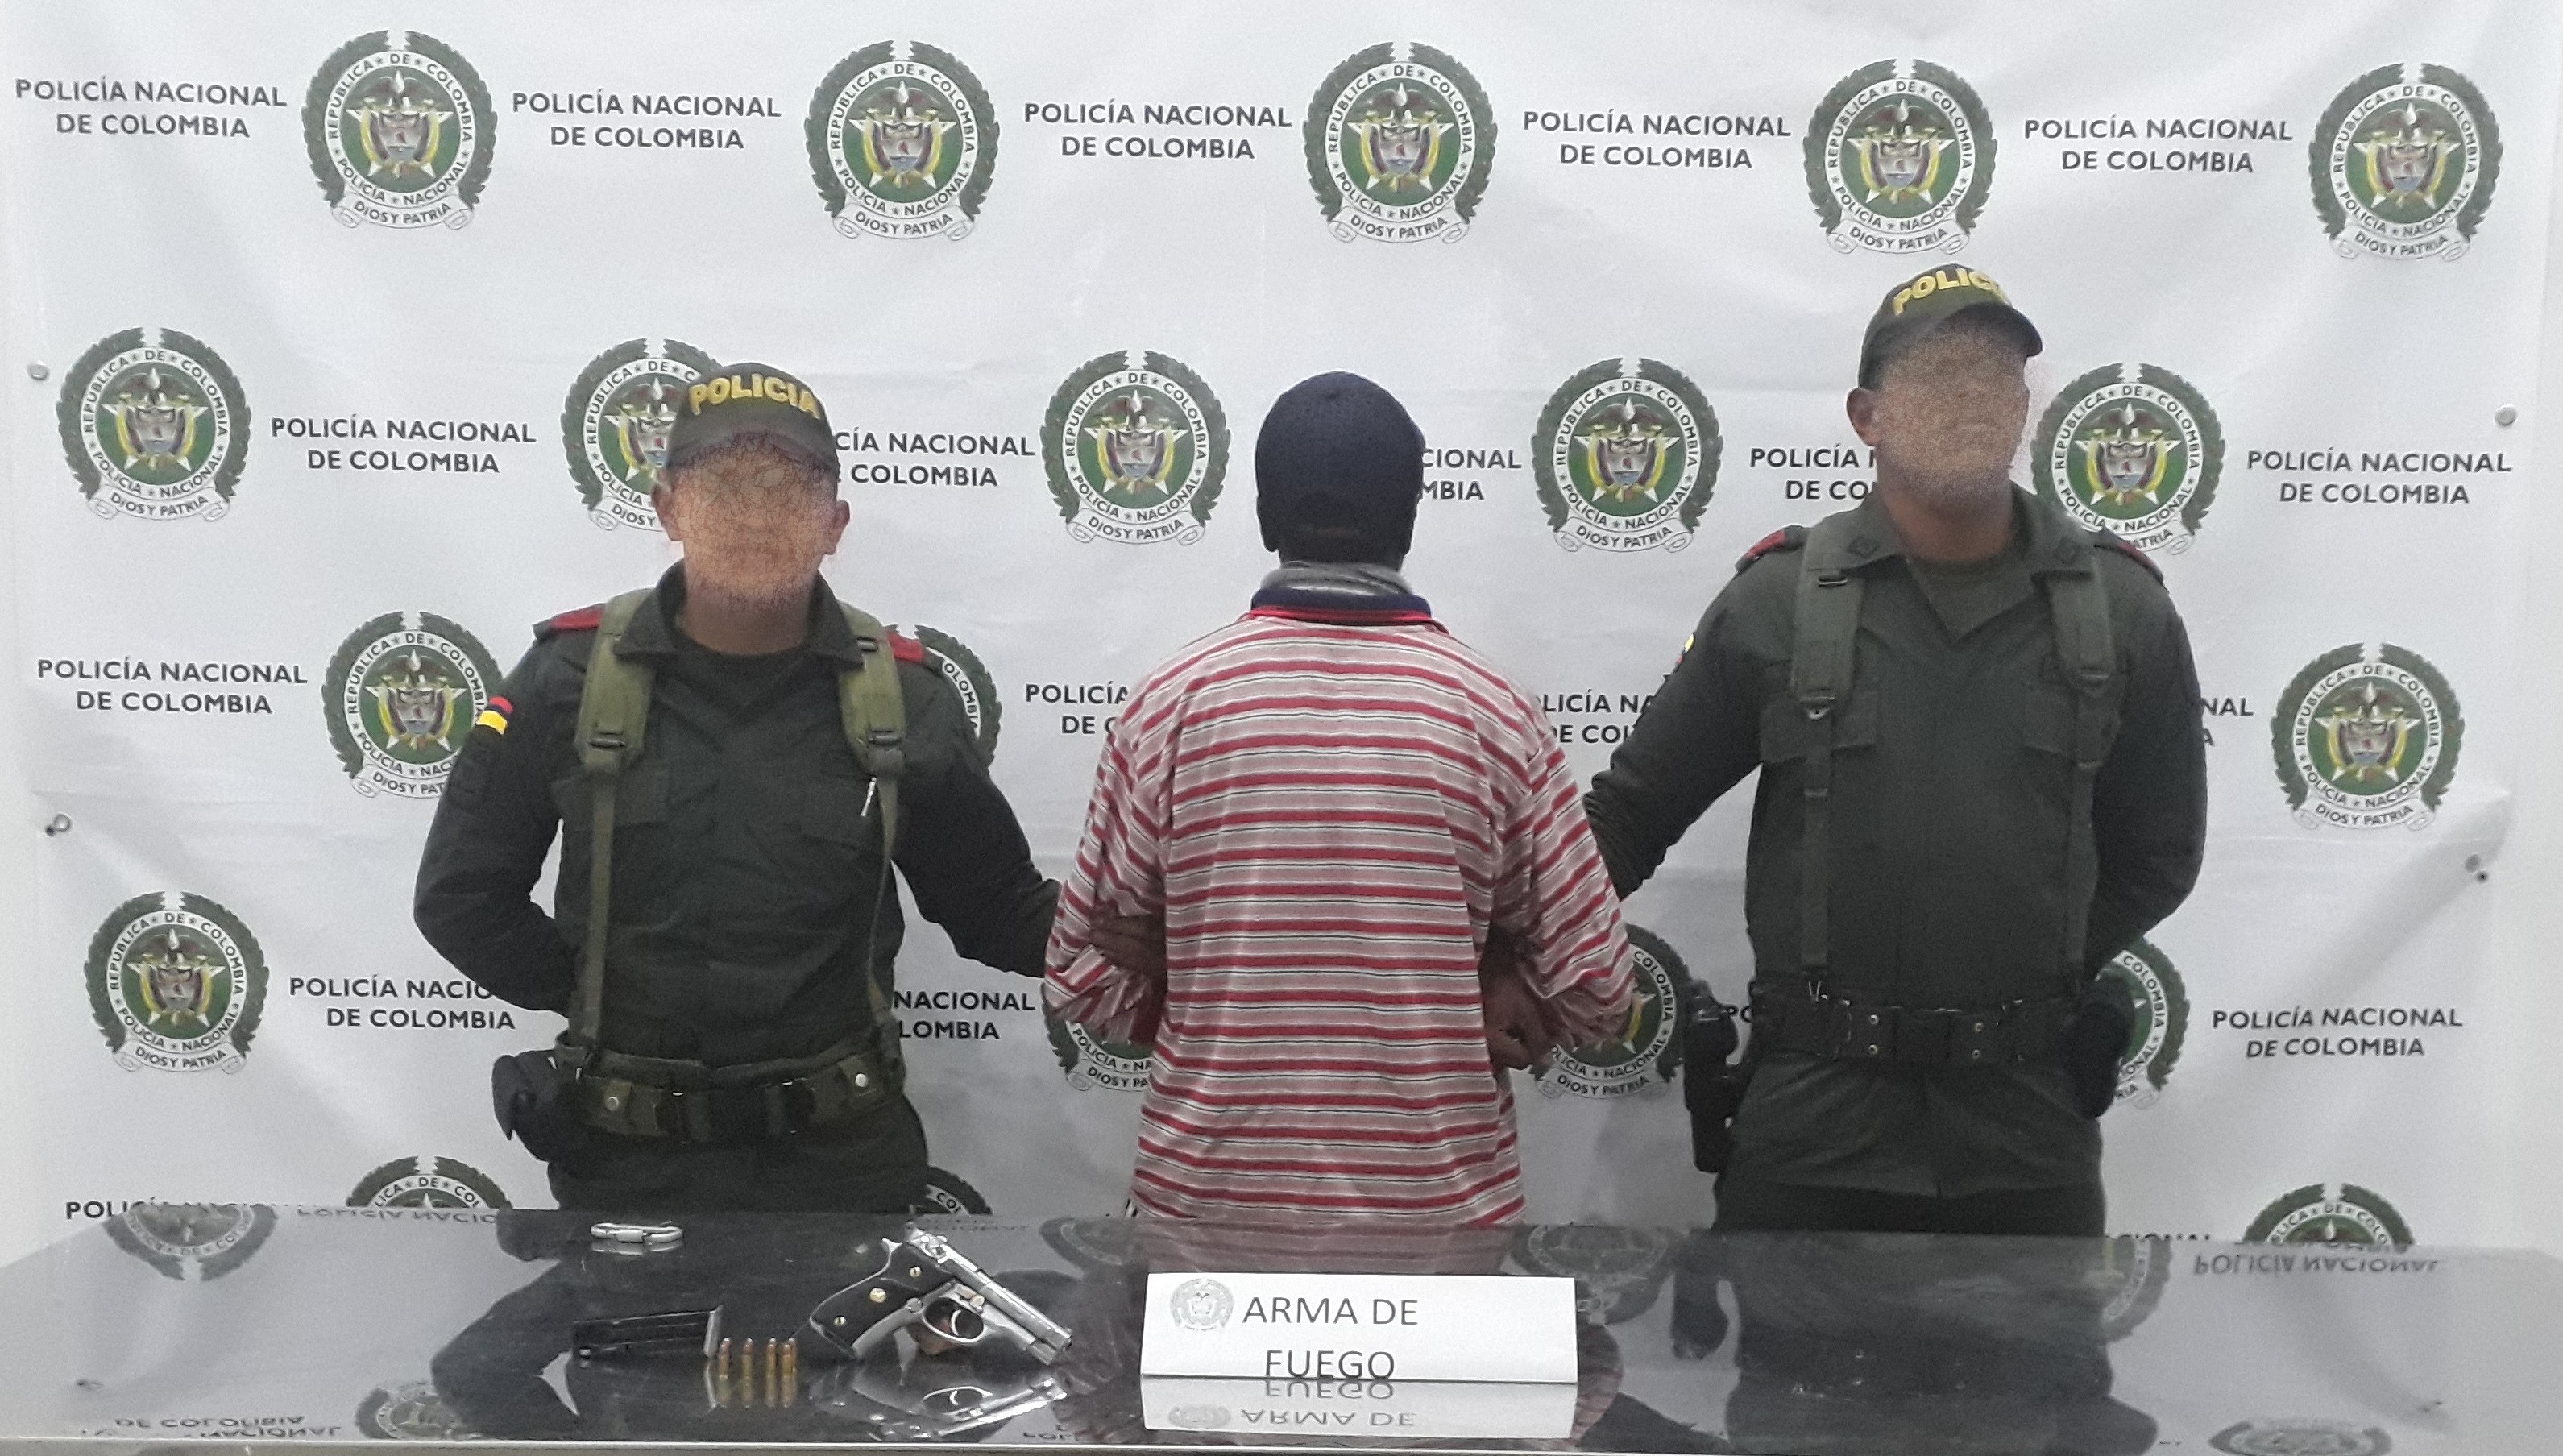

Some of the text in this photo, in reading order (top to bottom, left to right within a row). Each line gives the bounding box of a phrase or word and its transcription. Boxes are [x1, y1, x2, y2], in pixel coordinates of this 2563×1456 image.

[15, 74, 288, 107] POLICÍA NACIONAL
[389, 53, 410, 64] DE
[427, 63, 473, 141] COLOMBIA
[512, 88, 782, 118] POLICÍA NACIONAL
[894, 64, 914, 75] DE
[931, 73, 975, 152] COLOMBIA
[1025, 97, 1292, 127] POLICÍA NACIONAL
[1393, 65, 1413, 77] DE
[1430, 75, 1473, 154] COLOMBIA
[1524, 106, 1791, 137] POLICÍA NACIONAL
[56, 114, 250, 138] DE COLOMBIA
[550, 126, 744, 149] DE COLOMBIA
[1894, 84, 1914, 94] DE
[1931, 93, 1972, 168] COLOMBIA
[2025, 114, 2293, 141] POLICÍA NACIONAL
[1062, 136, 1255, 160] DE COLOMBIA
[1560, 144, 1752, 168] DE COLOMBIA
[2062, 151, 2254, 173] DE COLOMBIA
[404, 160, 467, 205] NACIONAL
[904, 170, 969, 216] NACIONAL
[1400, 172, 1465, 219] NACIONAL
[1900, 185, 1965, 230] NACIONAL
[648, 361, 668, 371] DE
[145, 350, 165, 361] DE
[182, 360, 228, 436] COLOMBIA
[689, 373, 819, 419] POLICIA
[272, 413, 537, 443] POLICÍA NACIONAL
[1128, 373, 1147, 384] DE
[1164, 383, 1207, 459] COLOMBIA
[1621, 380, 1641, 392] DE
[1657, 390, 1698, 467] COLOMBIA
[2122, 385, 2142, 396] DE
[2159, 394, 2200, 469] COLOMBIA
[888, 432, 1035, 456] NACIONAL
[1423, 448, 1522, 469] CIONAL
[1750, 443, 1860, 468] POLICÍA
[308, 450, 500, 473] DE COLOMBIA
[2247, 446, 2511, 473] POLICÍA NACIONAL
[160, 453, 222, 497] NACIONAL
[850, 463, 998, 487] COLOMBIA
[1785, 479, 1821, 500] DE
[1137, 477, 1200, 521] NACIONAL
[1625, 483, 1690, 529] NACIONAL
[2279, 482, 2470, 504] DE COLOMBIA
[2125, 486, 2192, 532] NACIONAL
[405, 633, 425, 644] DE
[38, 654, 308, 684] POLICÍA NACIONAL
[77, 691, 272, 714] DE COLOMBIA
[1541, 688, 1612, 714] LICÍA
[1061, 715, 1096, 735] DE
[165, 912, 185, 923] DE
[201, 922, 244, 994] COLOMBIA
[289, 974, 491, 999] POLICÍA NACIO
[893, 989, 1036, 1011] NACIONAL
[1634, 950, 1673, 1022] COLOMBIA
[180, 1010, 239, 1051] NACIONAL
[326, 1007, 516, 1030] DE COLOMBIA
[898, 1019, 1001, 1040] LOMBIA
[2213, 1005, 2463, 1030] POLICÍA NACIONAL
[2246, 1037, 2424, 1059] DE COLOMBIA
[418, 1176, 438, 1188] DE
[1242, 1296, 1419, 1325] ARMA DE
[1265, 1349, 1396, 1379] FUEGO
